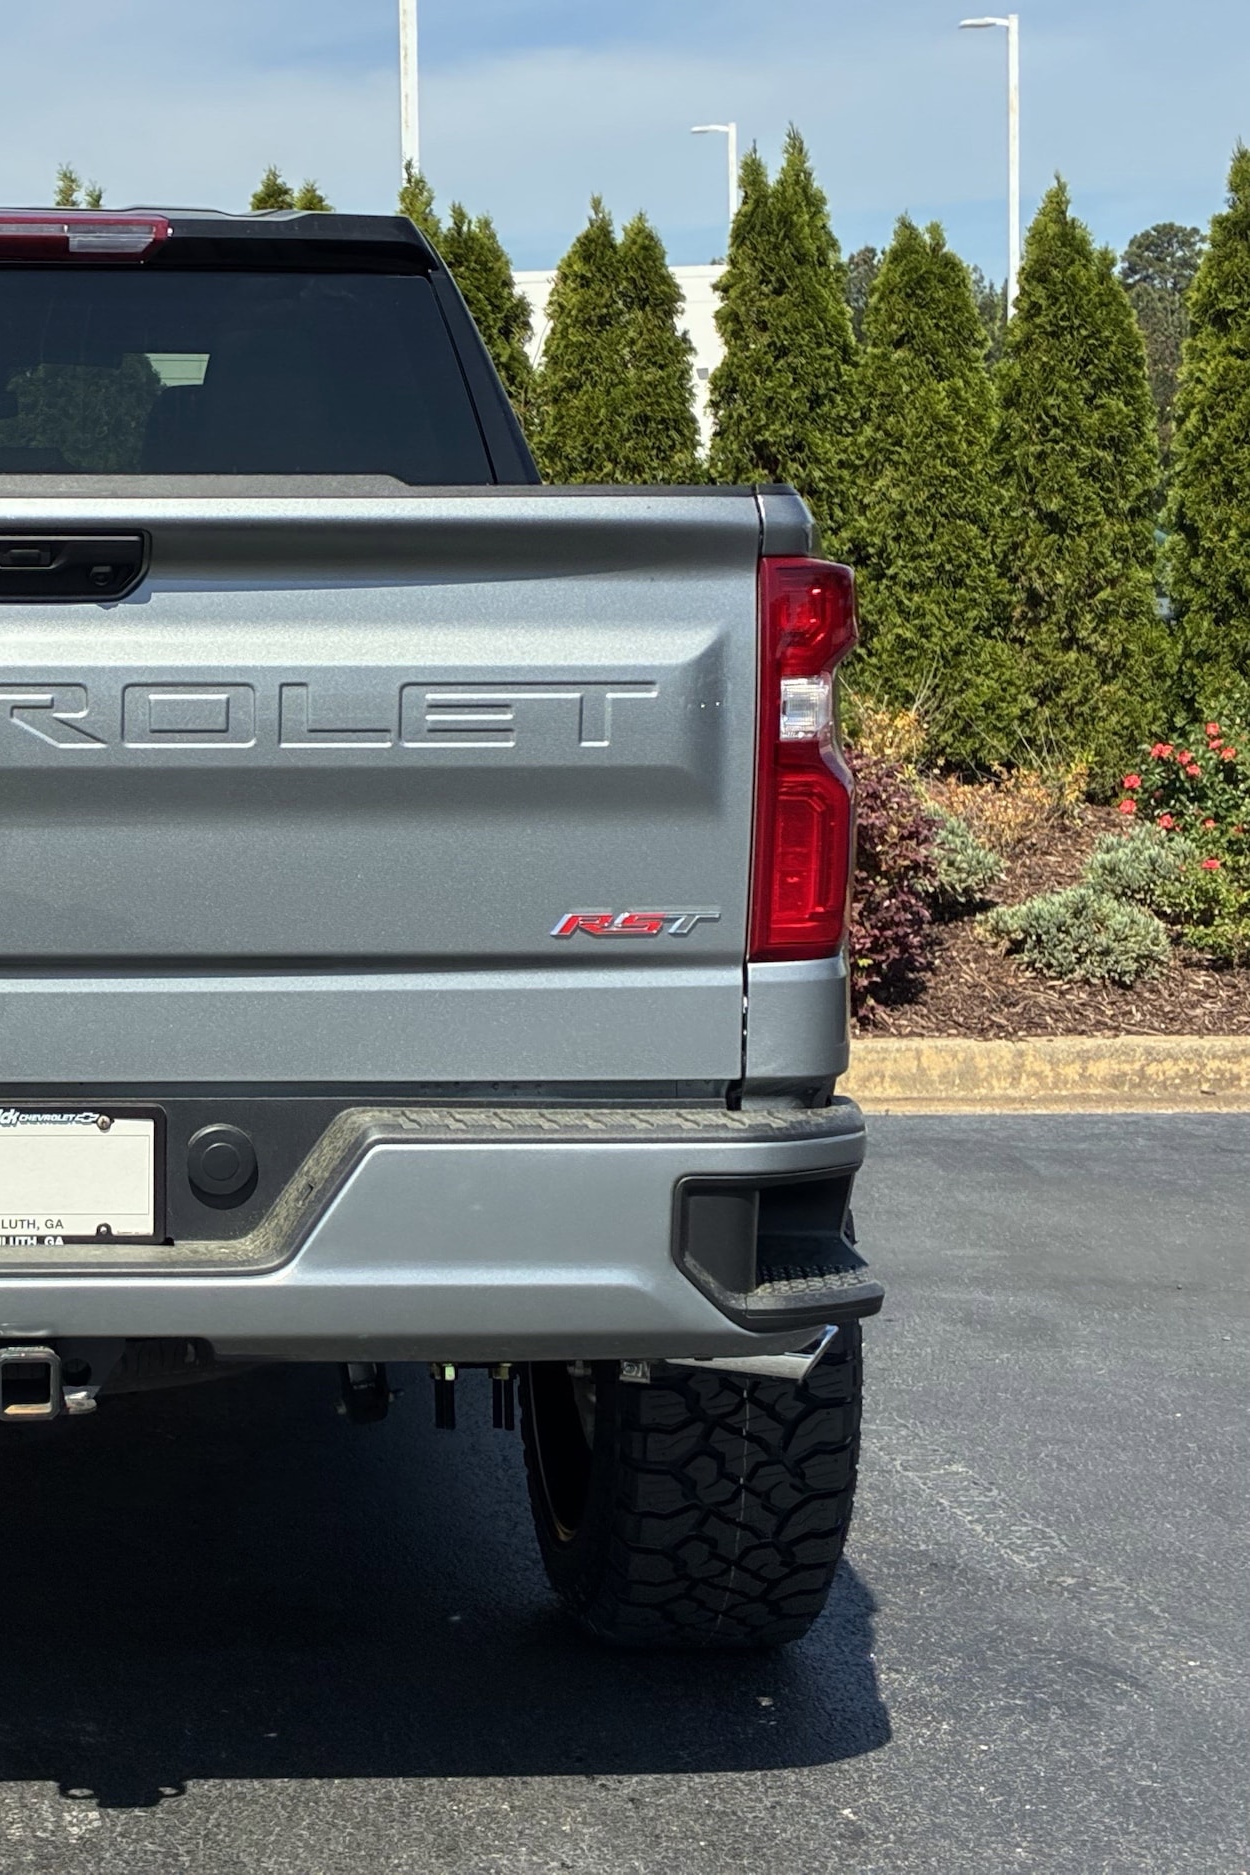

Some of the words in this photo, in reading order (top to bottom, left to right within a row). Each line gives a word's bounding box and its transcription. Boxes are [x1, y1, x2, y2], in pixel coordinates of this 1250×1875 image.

[550, 911, 721, 937] RST
[19, 1113, 76, 1123] CHEVROLET
[44, 1219, 64, 1230] GA
[44, 1236, 64, 1246] GA
